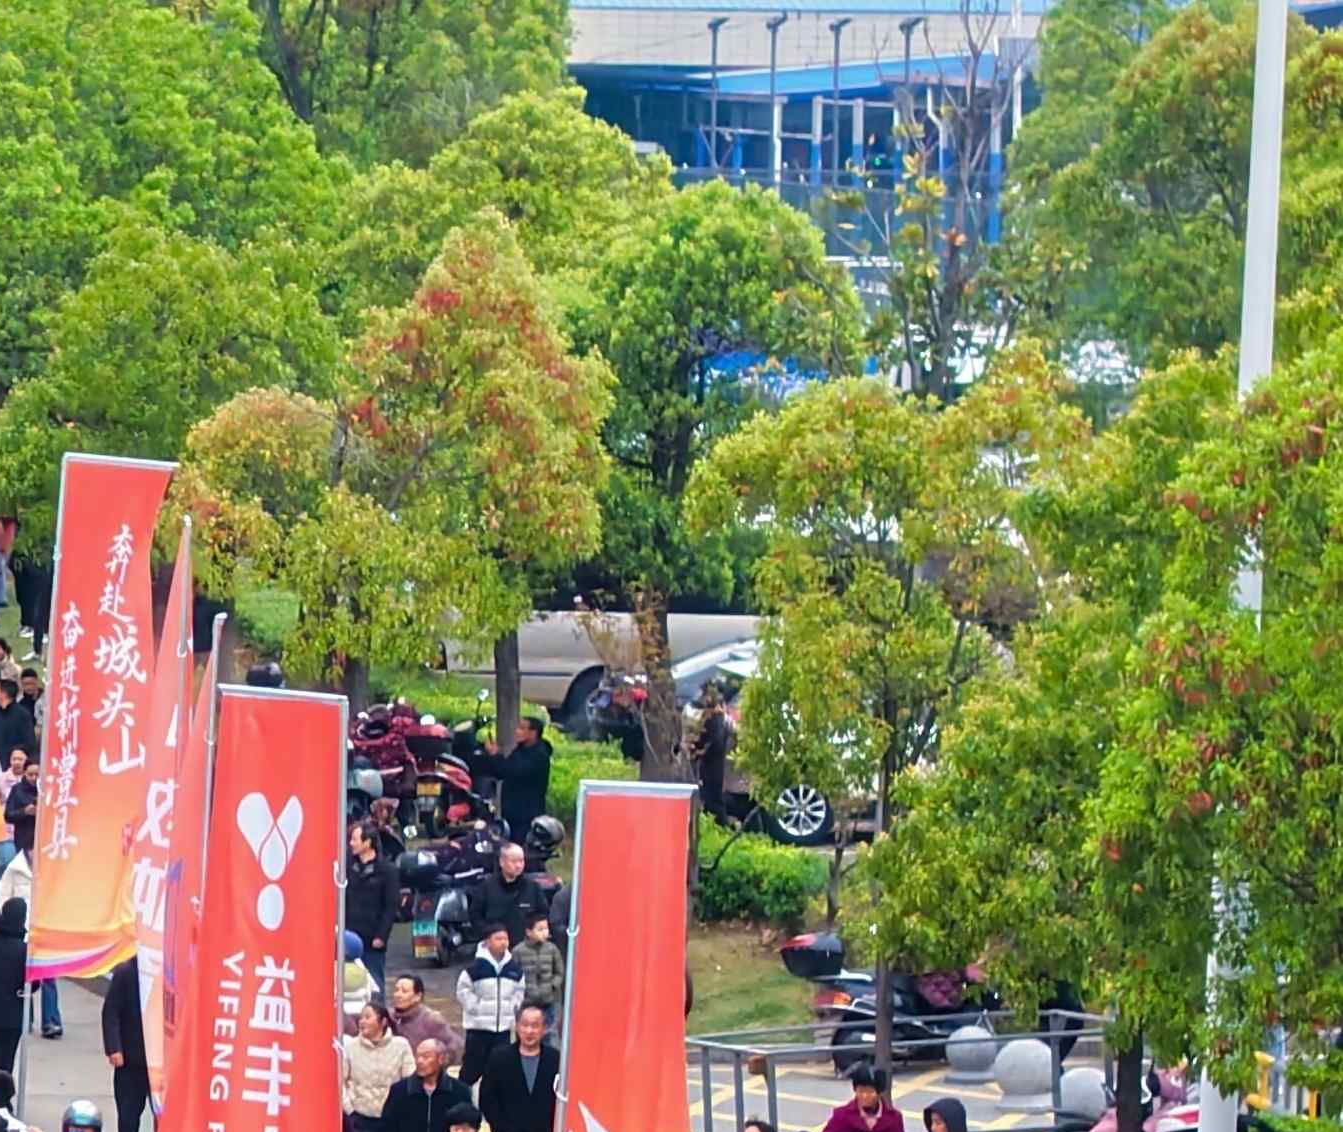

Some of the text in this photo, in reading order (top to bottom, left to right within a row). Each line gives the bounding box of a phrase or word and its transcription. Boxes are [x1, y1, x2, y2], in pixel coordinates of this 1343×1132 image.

[42, 602, 85, 861] 奋进新澧县
[93, 523, 148, 775] 奔赴城头山
[209, 951, 246, 1102] YIFENG
